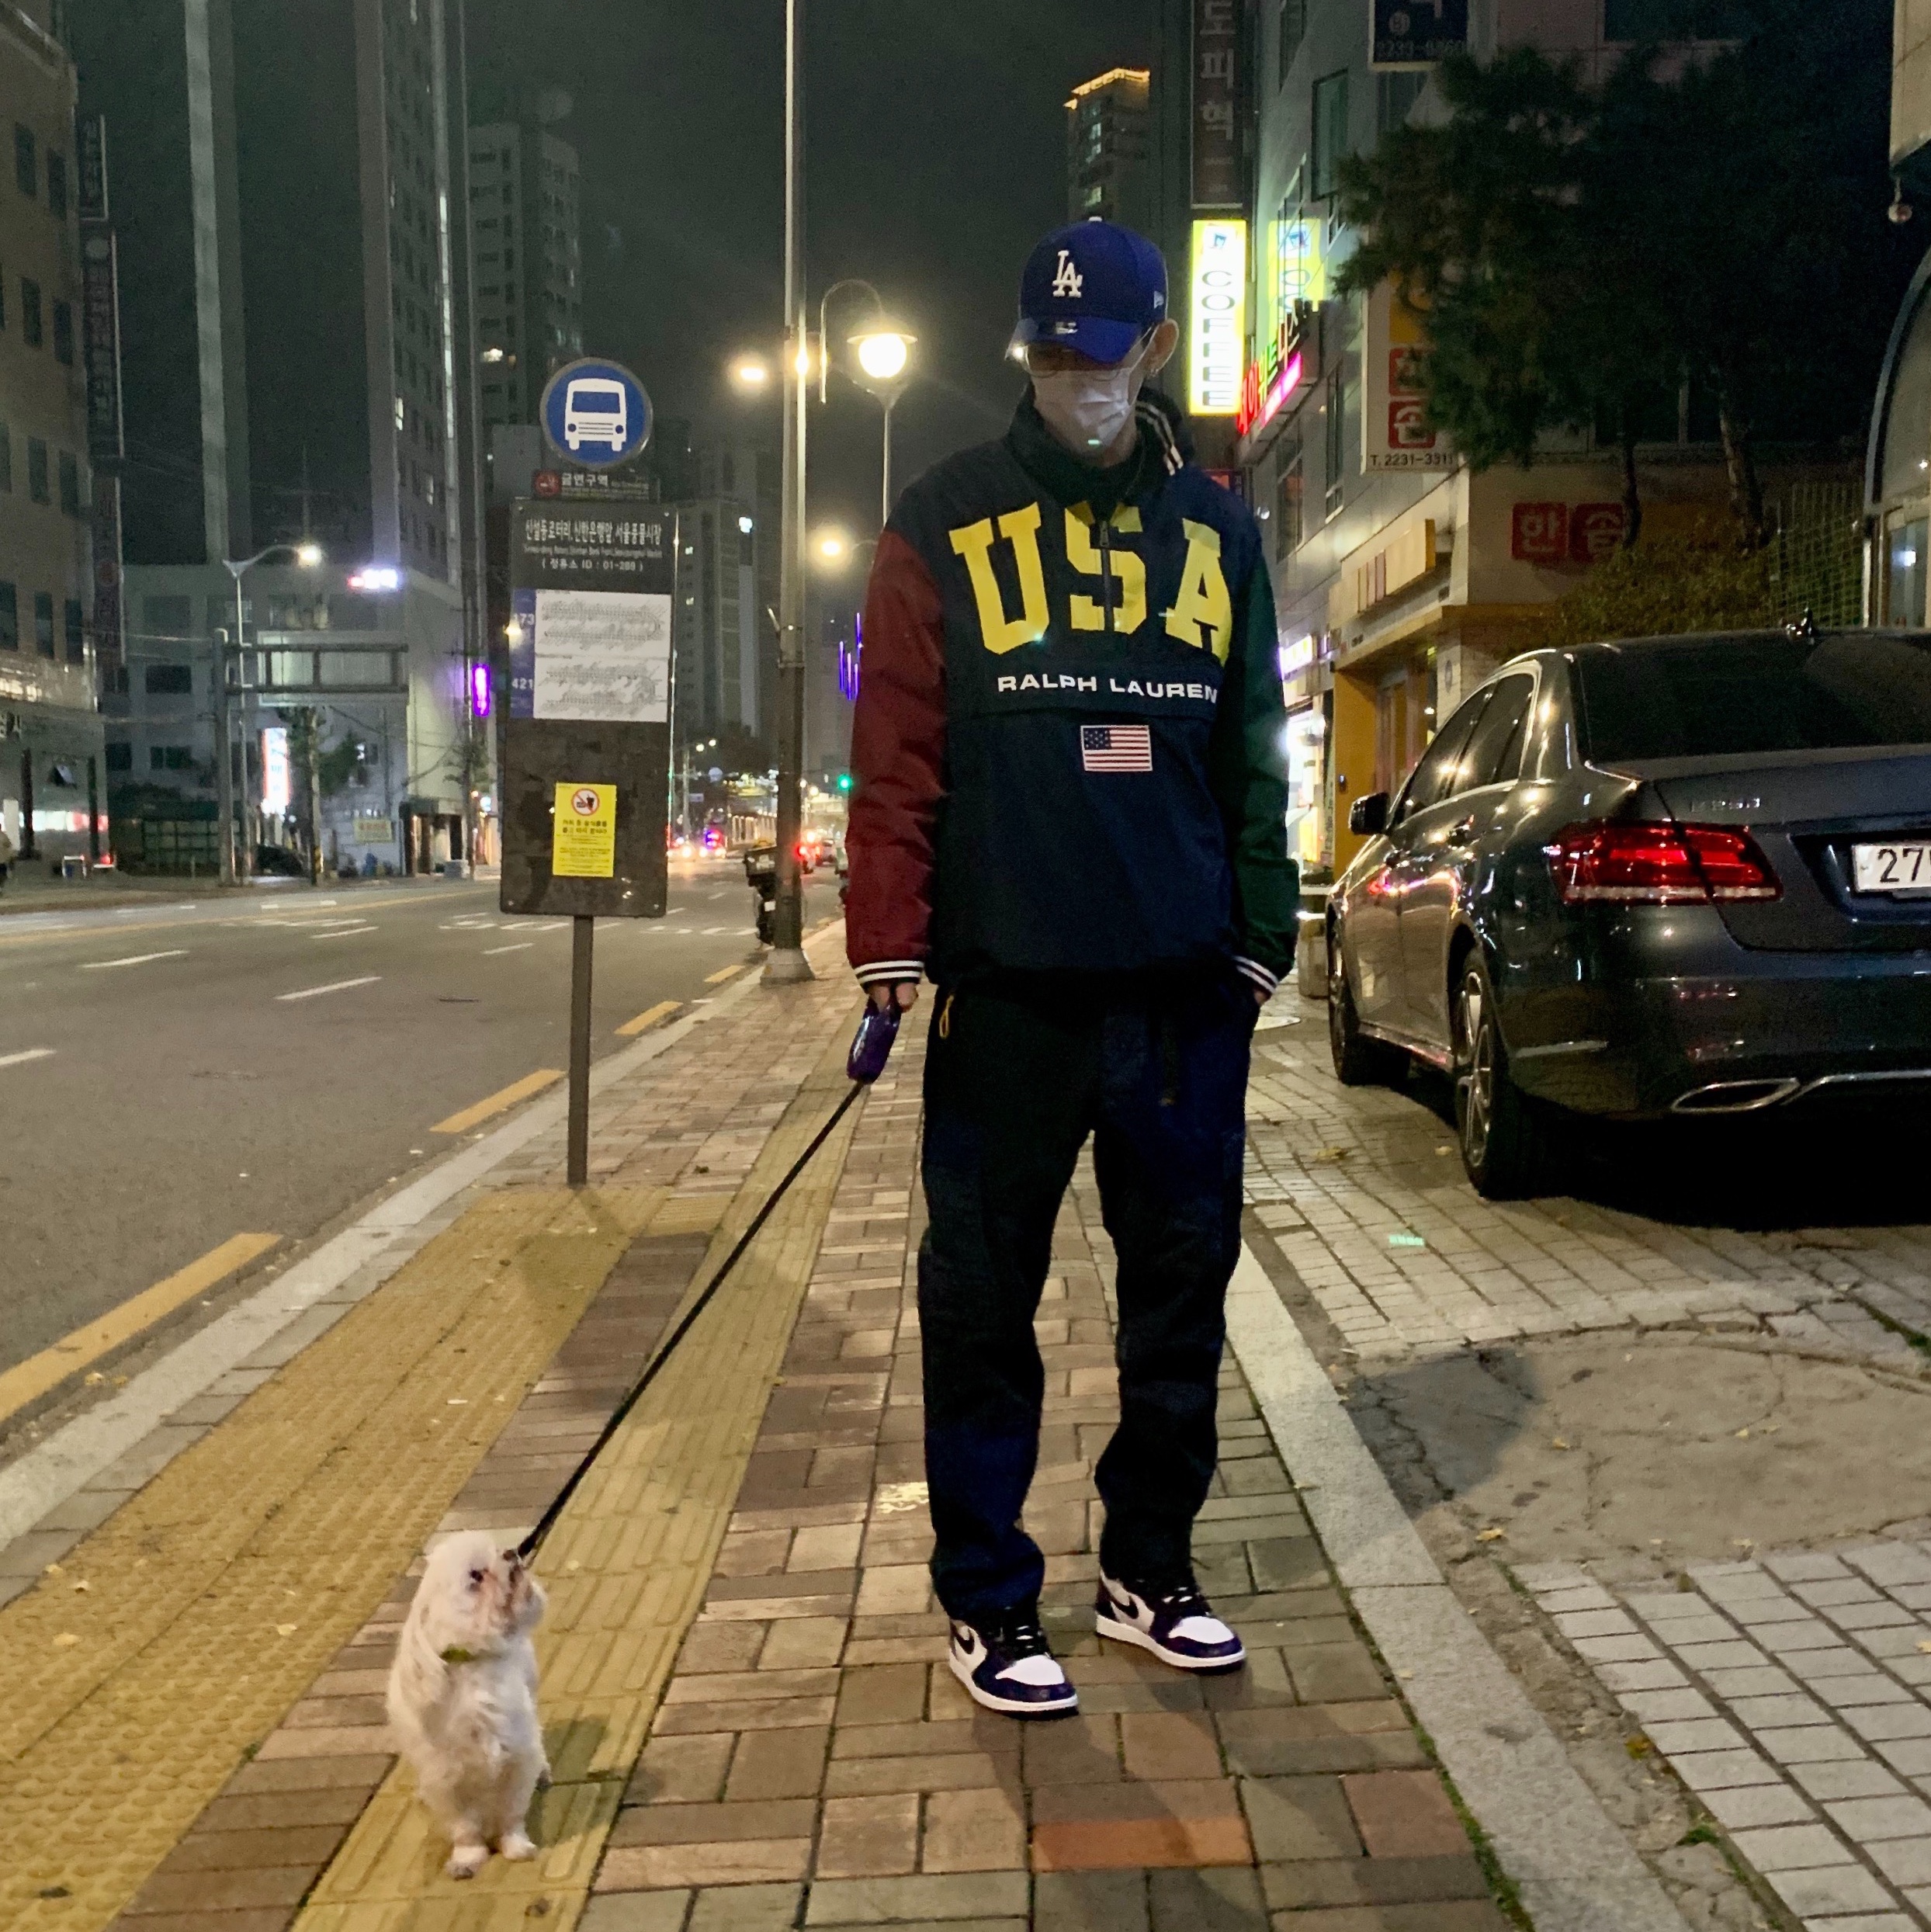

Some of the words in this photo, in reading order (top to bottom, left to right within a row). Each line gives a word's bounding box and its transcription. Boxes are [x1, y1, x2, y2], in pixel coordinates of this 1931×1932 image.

[1052, 250, 1083, 298] LA
[1201, 270, 1236, 407] COFFEE
[948, 501, 1232, 668] USA
[512, 677, 533, 690] 421
[997, 674, 1097, 692] RALPH
[1110, 678, 1218, 703] LAUREN
[1877, 847, 1931, 883] 27
